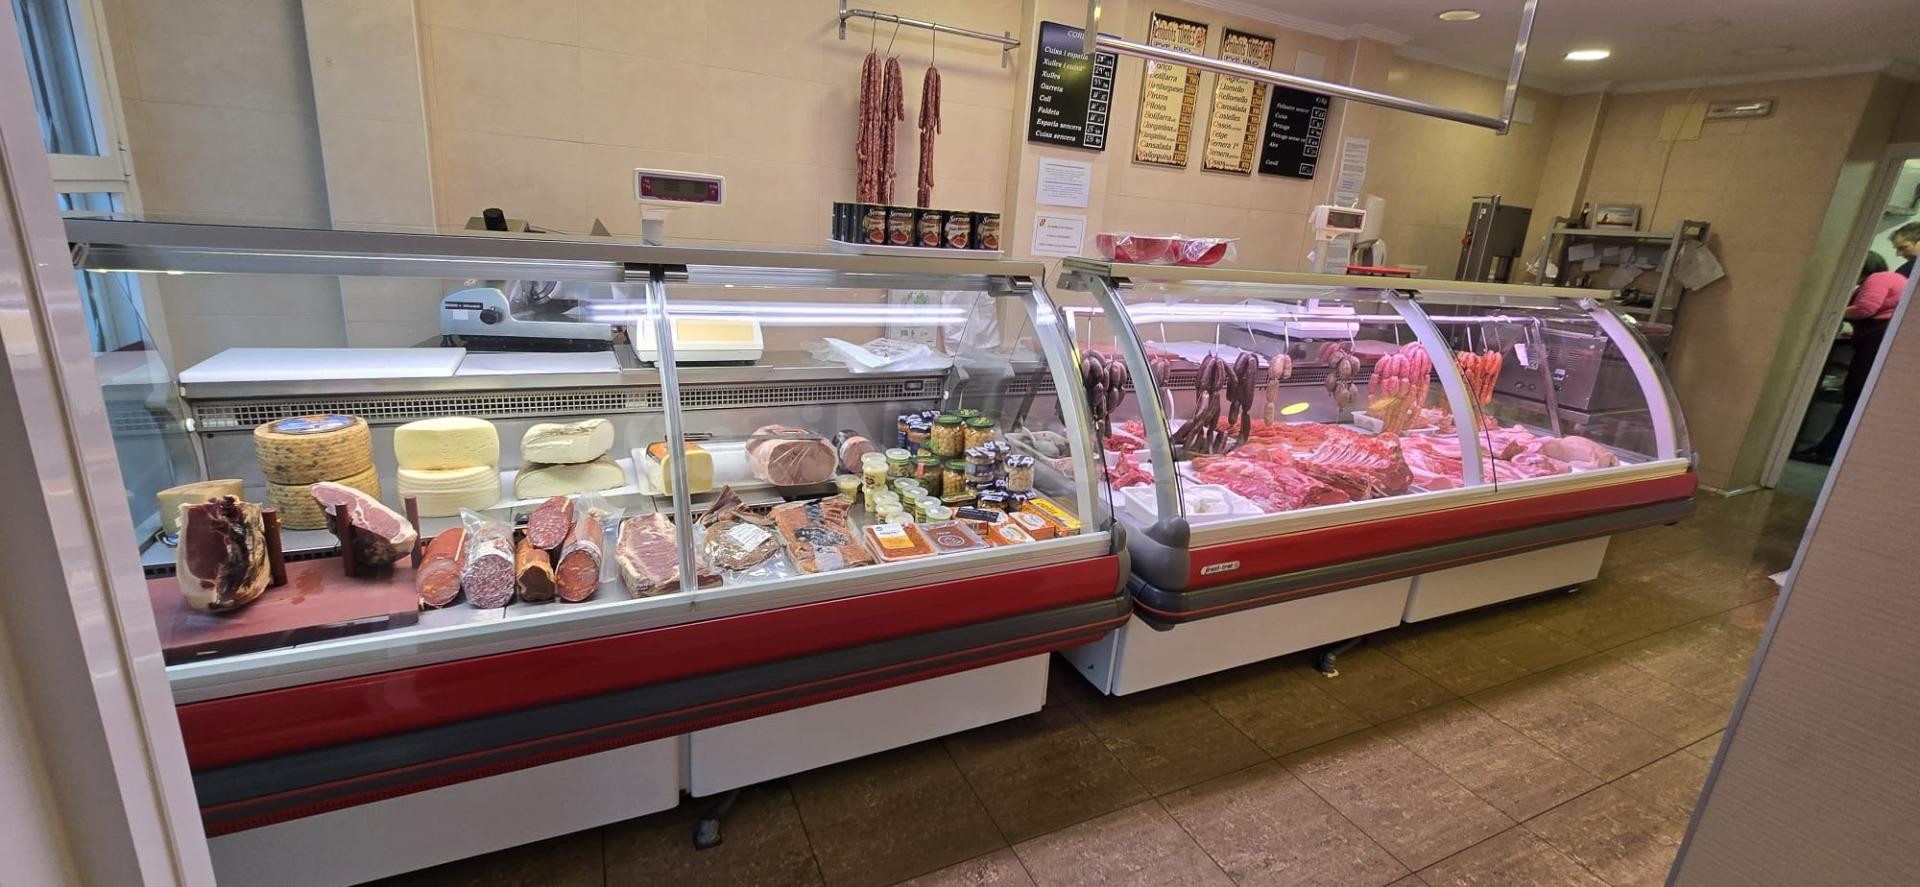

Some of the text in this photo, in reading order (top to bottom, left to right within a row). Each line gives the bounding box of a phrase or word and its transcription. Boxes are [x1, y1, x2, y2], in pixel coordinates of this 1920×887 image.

[1044, 46, 1063, 56] Cuixa
[1042, 58, 1063, 68] Xulles
[1041, 71, 1061, 80] Xulles
[1039, 94, 1052, 103] Coll
[1036, 118, 1059, 128] Espatla
[1035, 130, 1053, 139] Cuixa
